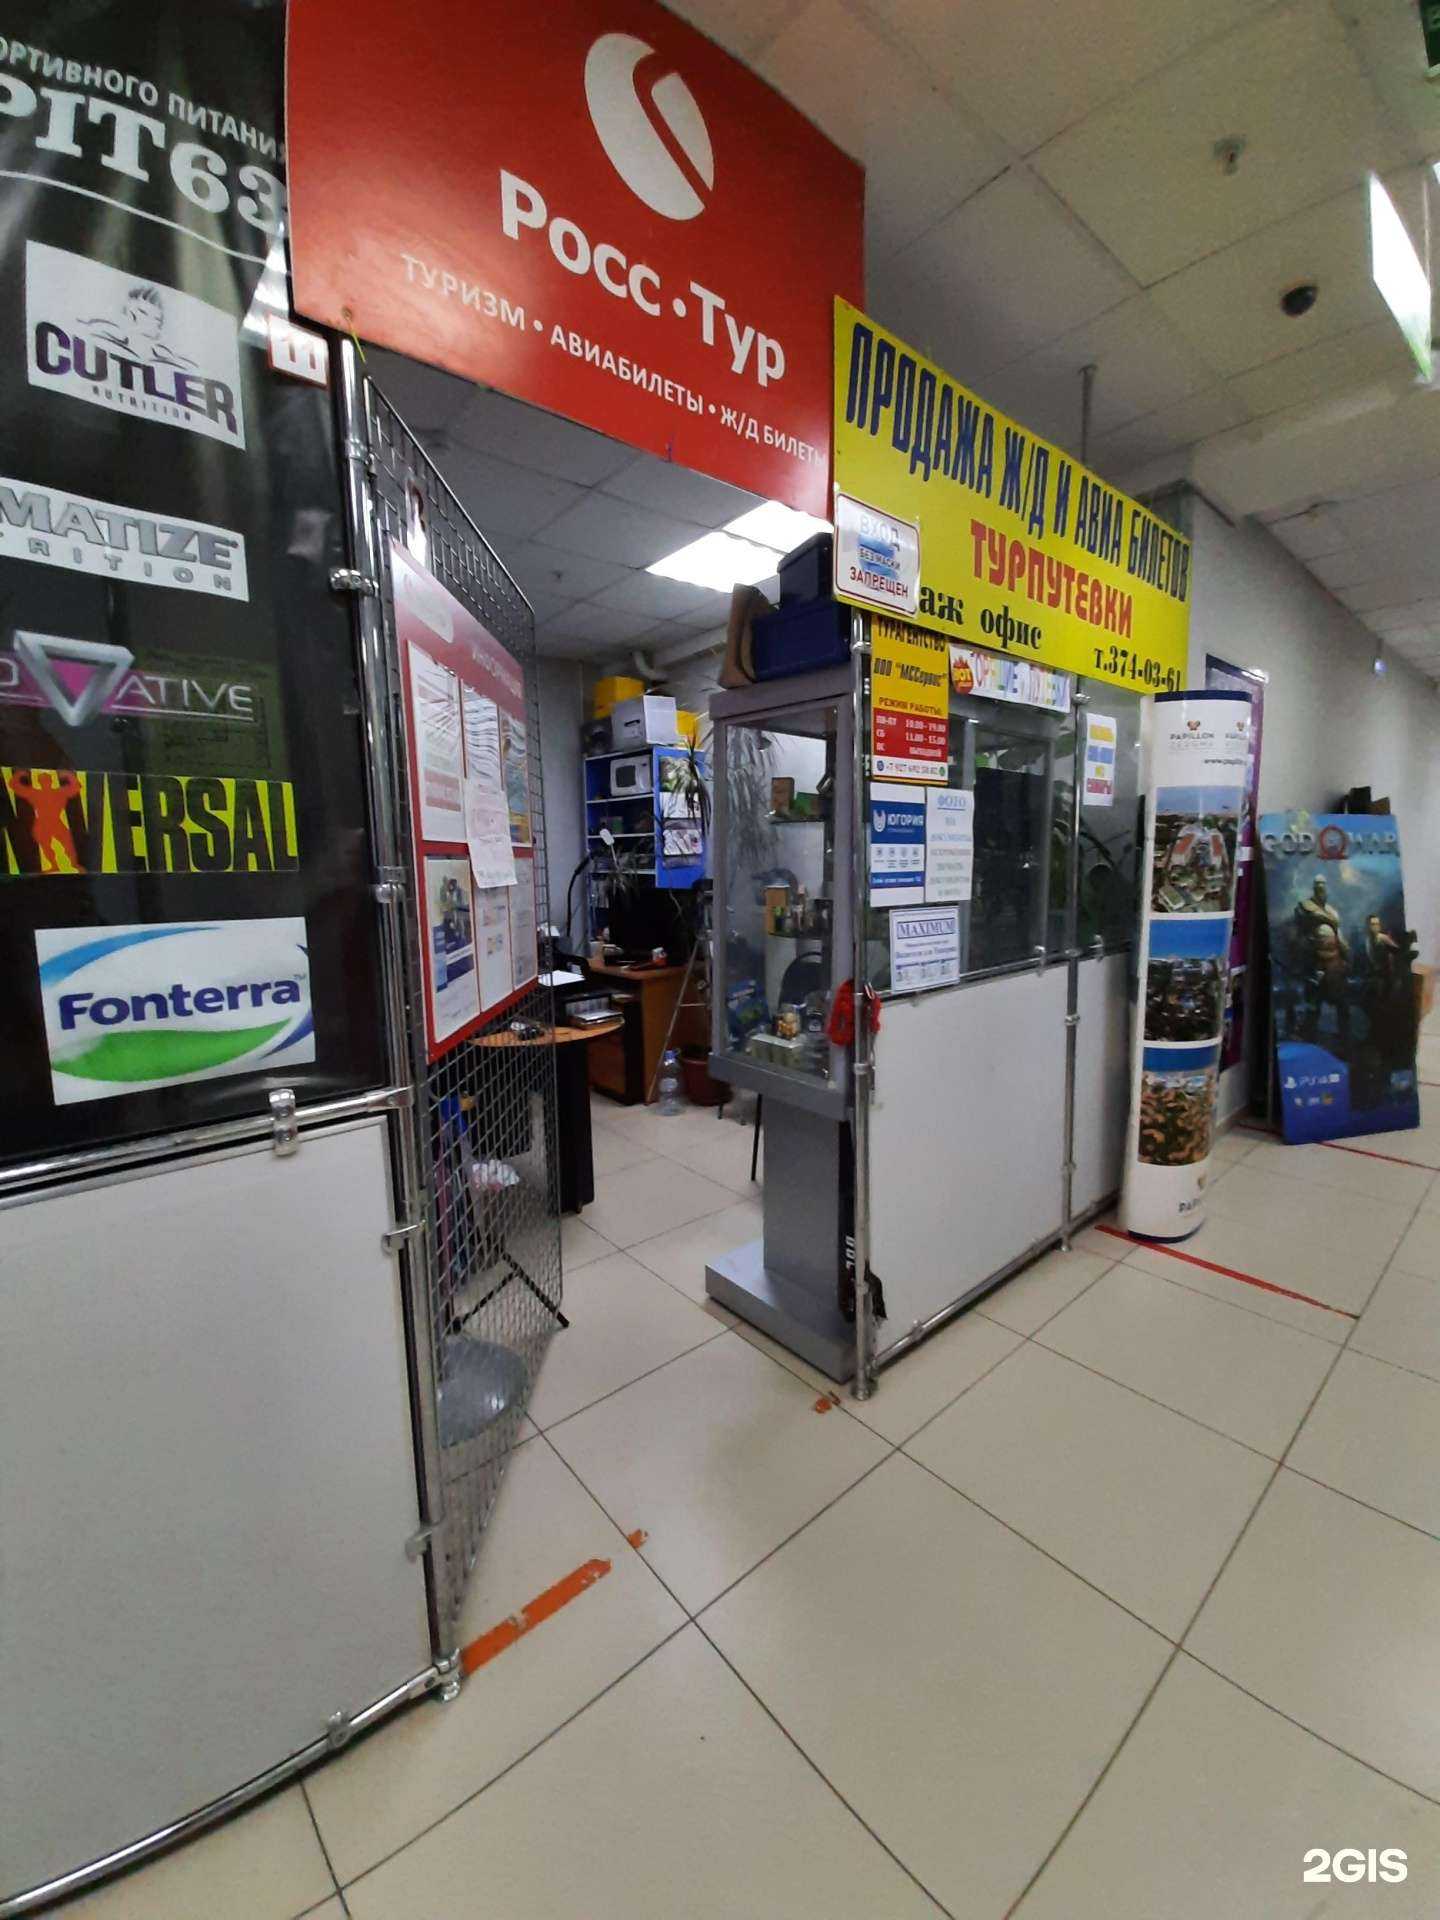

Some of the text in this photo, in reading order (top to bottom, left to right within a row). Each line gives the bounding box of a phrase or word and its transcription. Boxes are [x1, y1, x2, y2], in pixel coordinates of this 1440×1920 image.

[401, 253, 826, 466] ТУРИЗМ АВИАБИЛЕТЫ Ж/Д БИЛЕТЫ
[689, 280, 786, 387] Тур
[35, 321, 238, 435] CUTLER
[845, 322, 1191, 603] ПРОДАЖА Ж/Д И АВИА БИЛЕТОВ
[860, 514, 900, 552] ВХОД
[849, 566, 909, 598] ЗАПРЕЩЕН
[969, 518, 1133, 640] ТУРПУТЕВКИ
[980, 605, 1043, 650] офис
[887, 814, 924, 826] ЮГОРИЯ
[58, 979, 300, 1030] Fonterra
